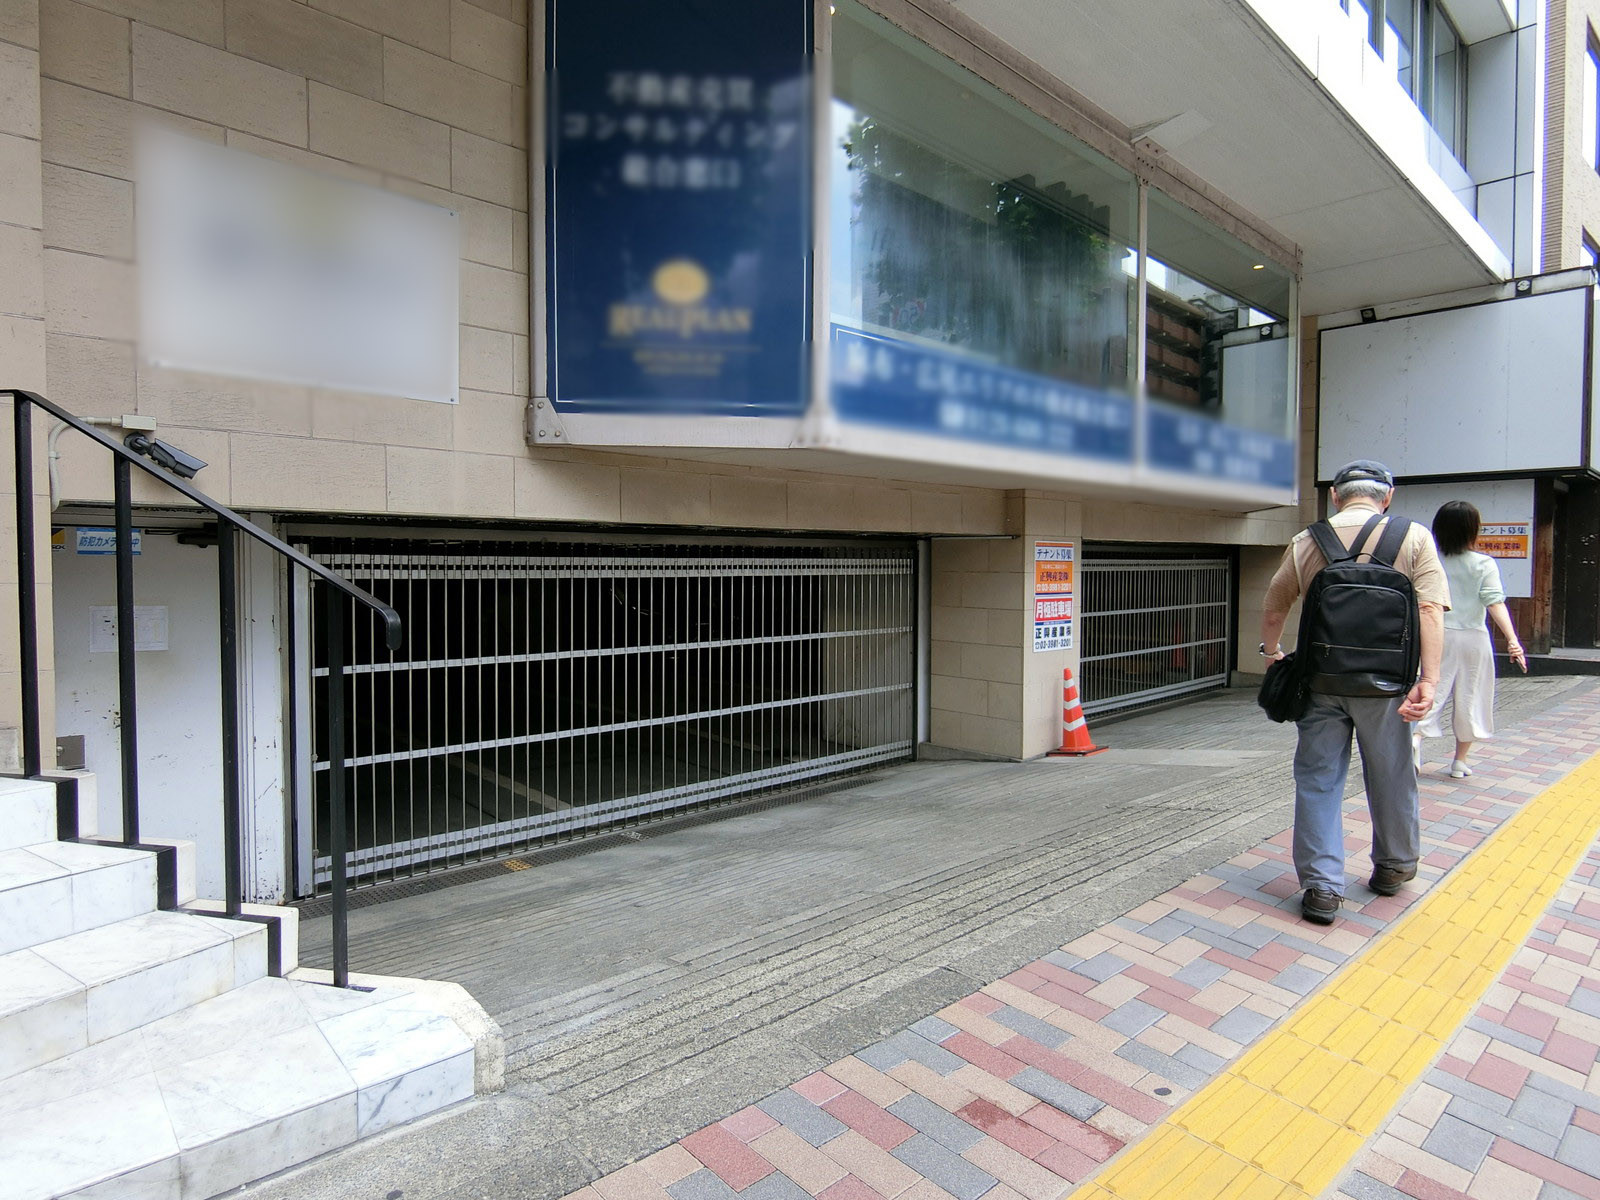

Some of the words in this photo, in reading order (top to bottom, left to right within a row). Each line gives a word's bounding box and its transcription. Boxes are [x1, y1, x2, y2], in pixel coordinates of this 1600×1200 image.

[1481, 526, 1526, 534] ナント募集
[78, 536, 139, 547] 防犯カメラ中
[1037, 549, 1072, 559] テナント募集
[1037, 601, 1071, 618] 月極駐車場
